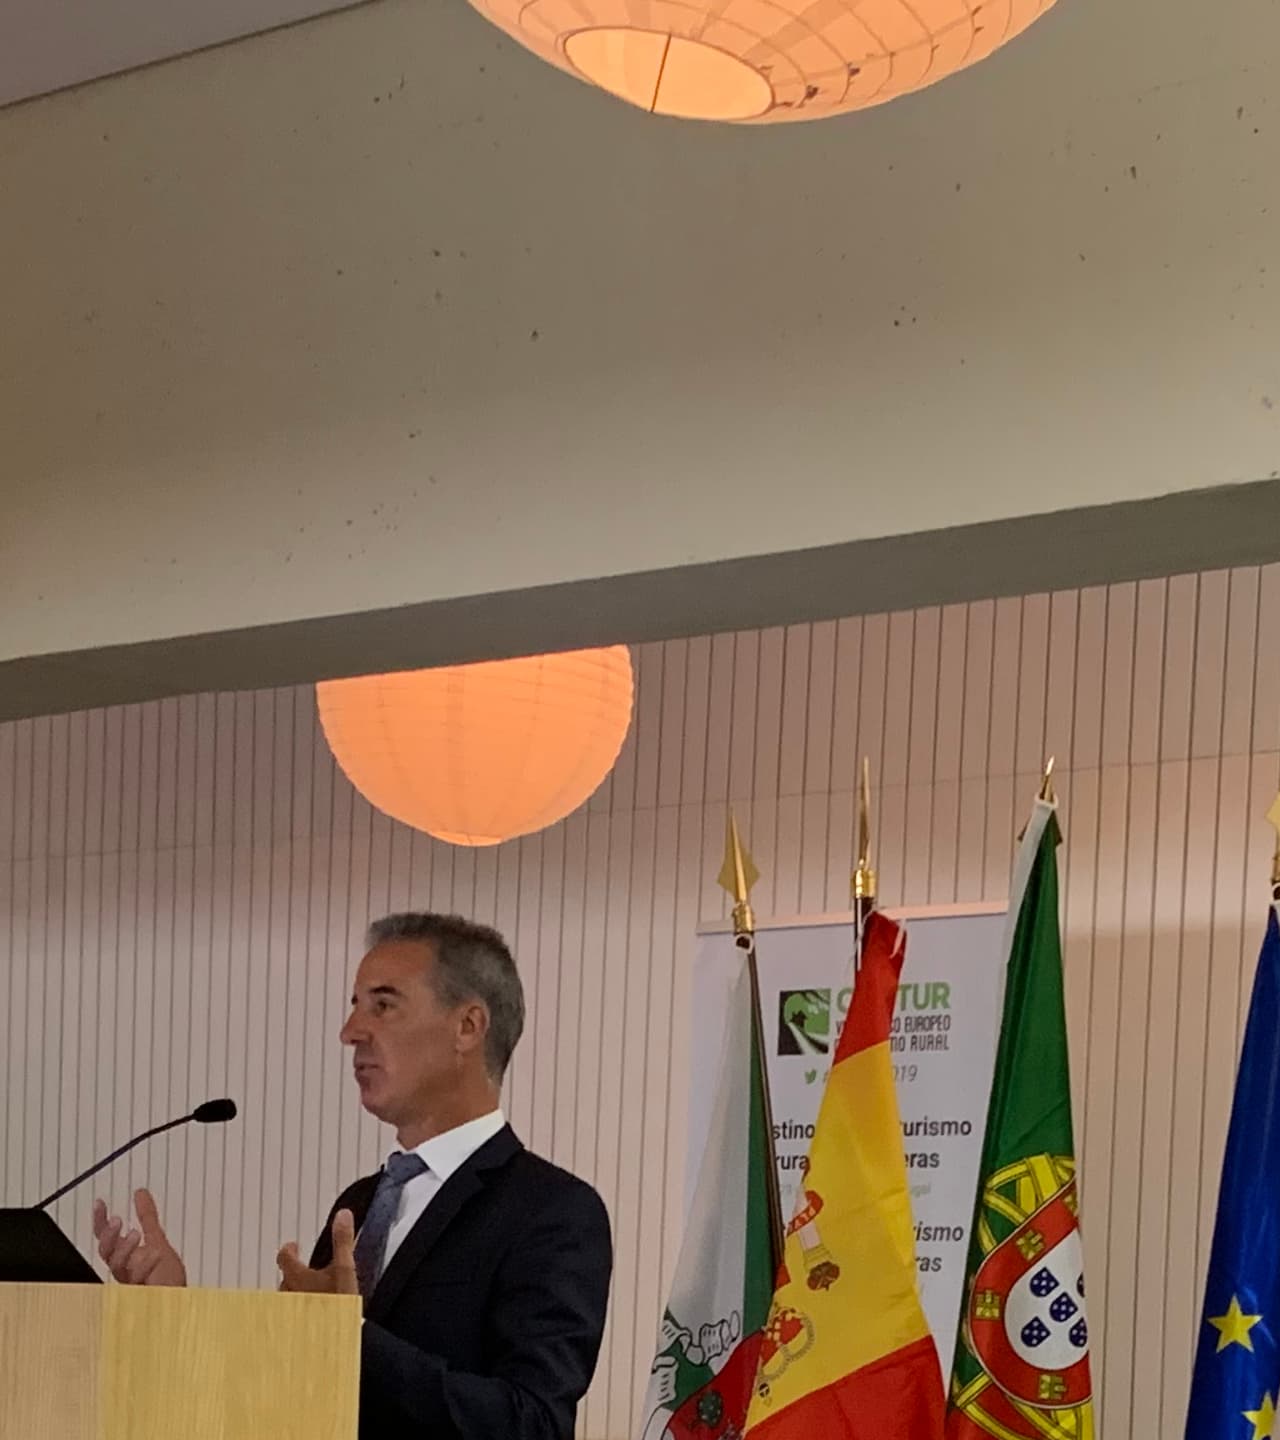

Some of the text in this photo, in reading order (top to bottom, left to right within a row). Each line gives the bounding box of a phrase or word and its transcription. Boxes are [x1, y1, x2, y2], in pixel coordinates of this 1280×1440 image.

[904, 1014, 951, 1033] EUROPEO
[910, 1036, 950, 1051] RURAL
[900, 1116, 972, 1137] urismo
